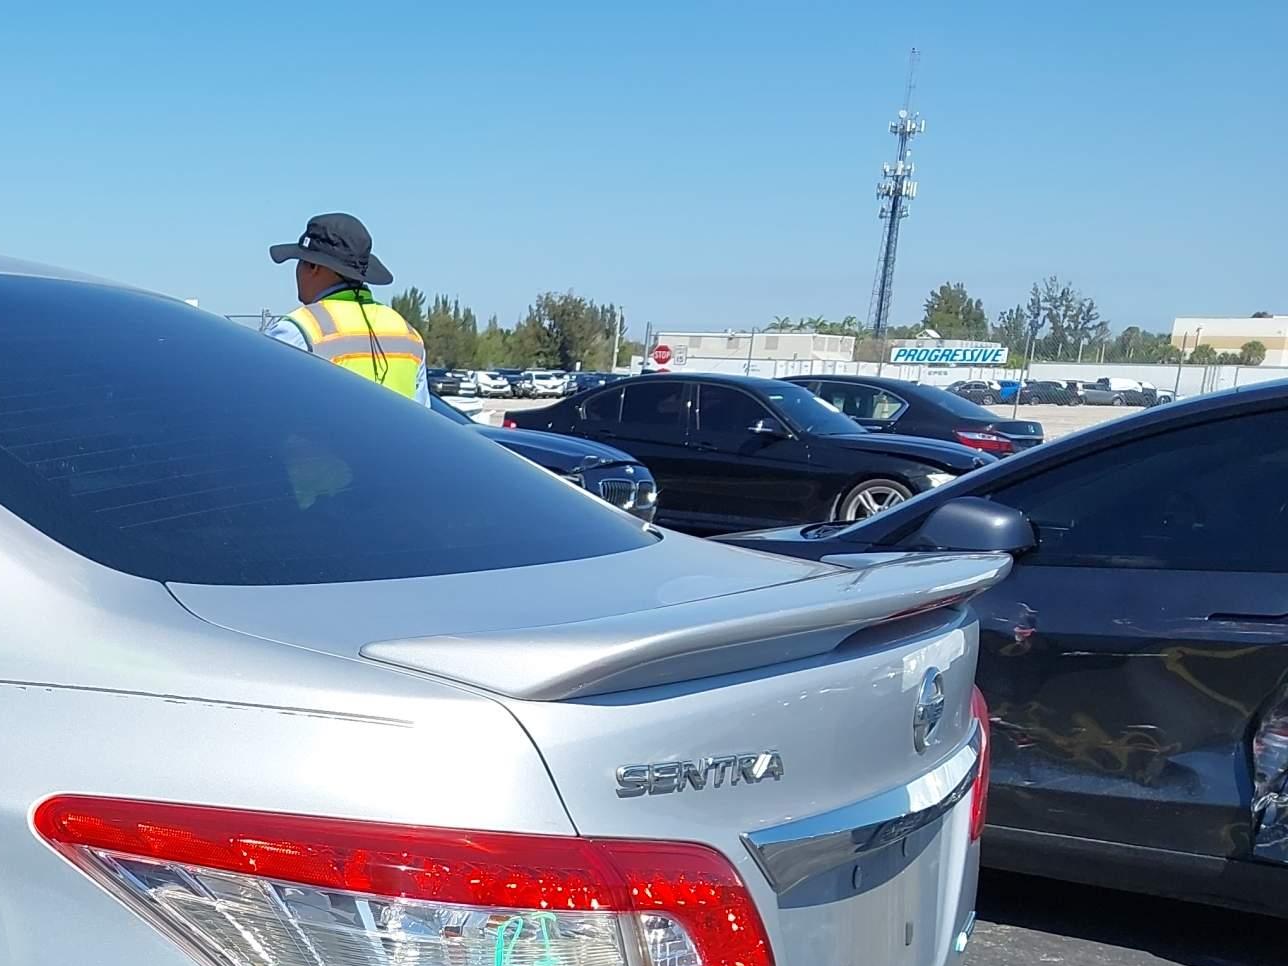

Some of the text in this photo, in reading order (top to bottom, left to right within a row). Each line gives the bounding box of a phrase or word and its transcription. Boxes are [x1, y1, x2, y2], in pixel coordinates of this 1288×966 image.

[654, 350, 671, 359] STOP
[893, 348, 1005, 362] PROGRESSIVE
[615, 749, 784, 798] SENTRA
